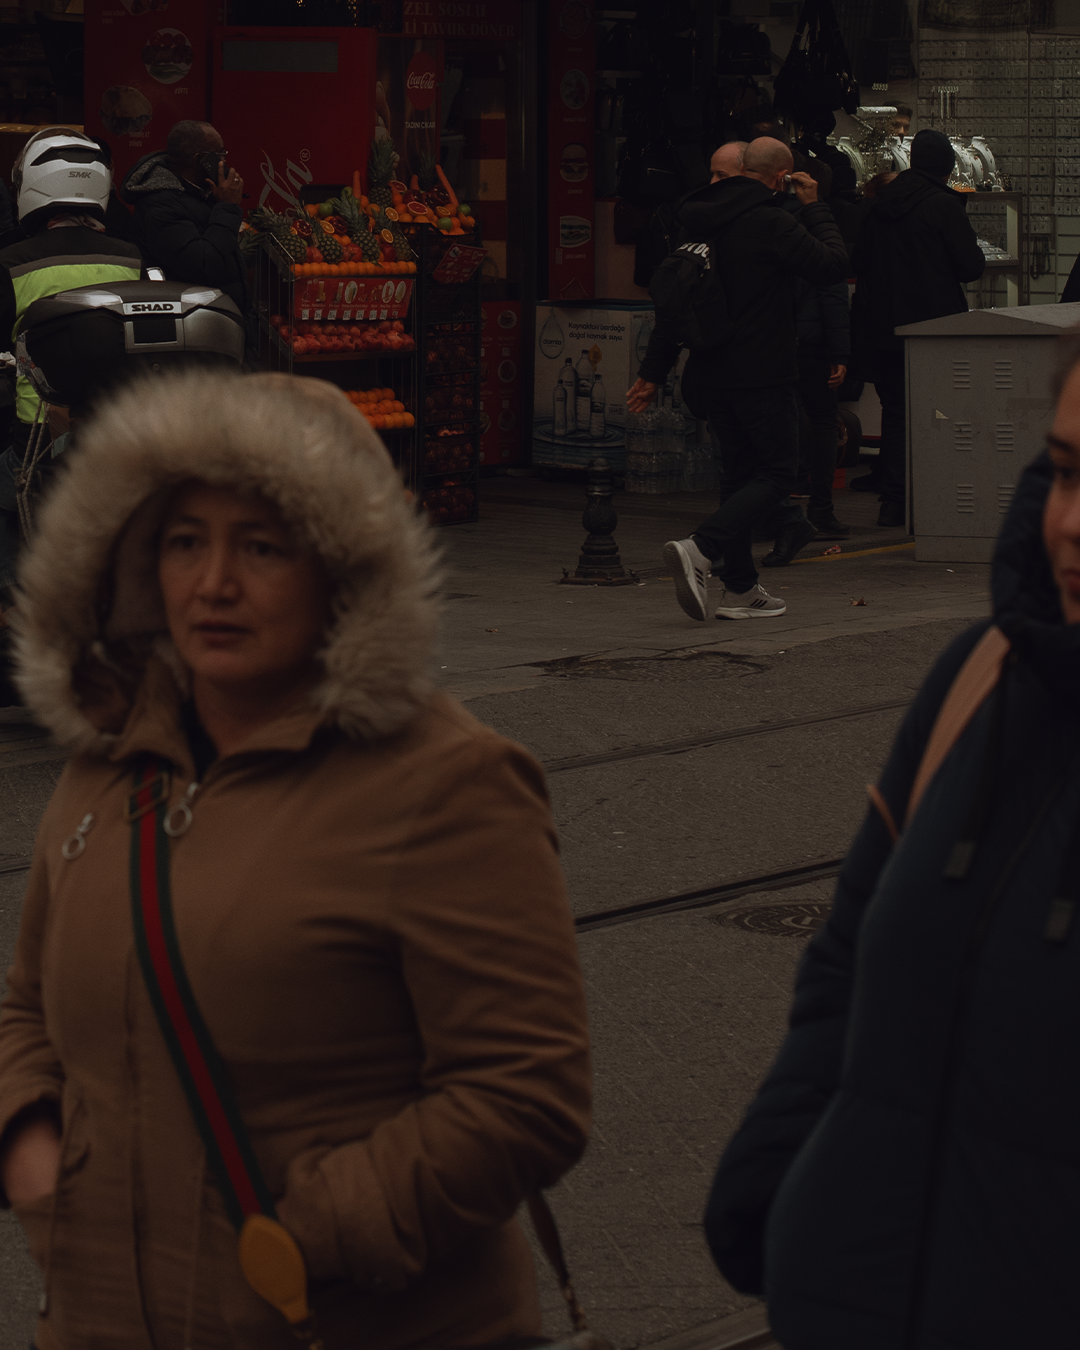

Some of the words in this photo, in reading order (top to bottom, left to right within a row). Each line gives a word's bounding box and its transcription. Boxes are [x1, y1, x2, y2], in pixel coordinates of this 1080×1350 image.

[404, 1, 434, 16] ZEL
[438, 2, 486, 18] SOSLU
[421, 21, 467, 36] TAVUK
[470, 20, 515, 37] DÖNER
[405, 121, 420, 129] TADINI
[421, 121, 435, 130] ÇIKAR
[68, 171, 92, 179] SMK
[131, 303, 174, 312] SHAD
[569, 331, 586, 340] doğal
[587, 332, 608, 341] kaynak
[542, 338, 562, 346] damla
